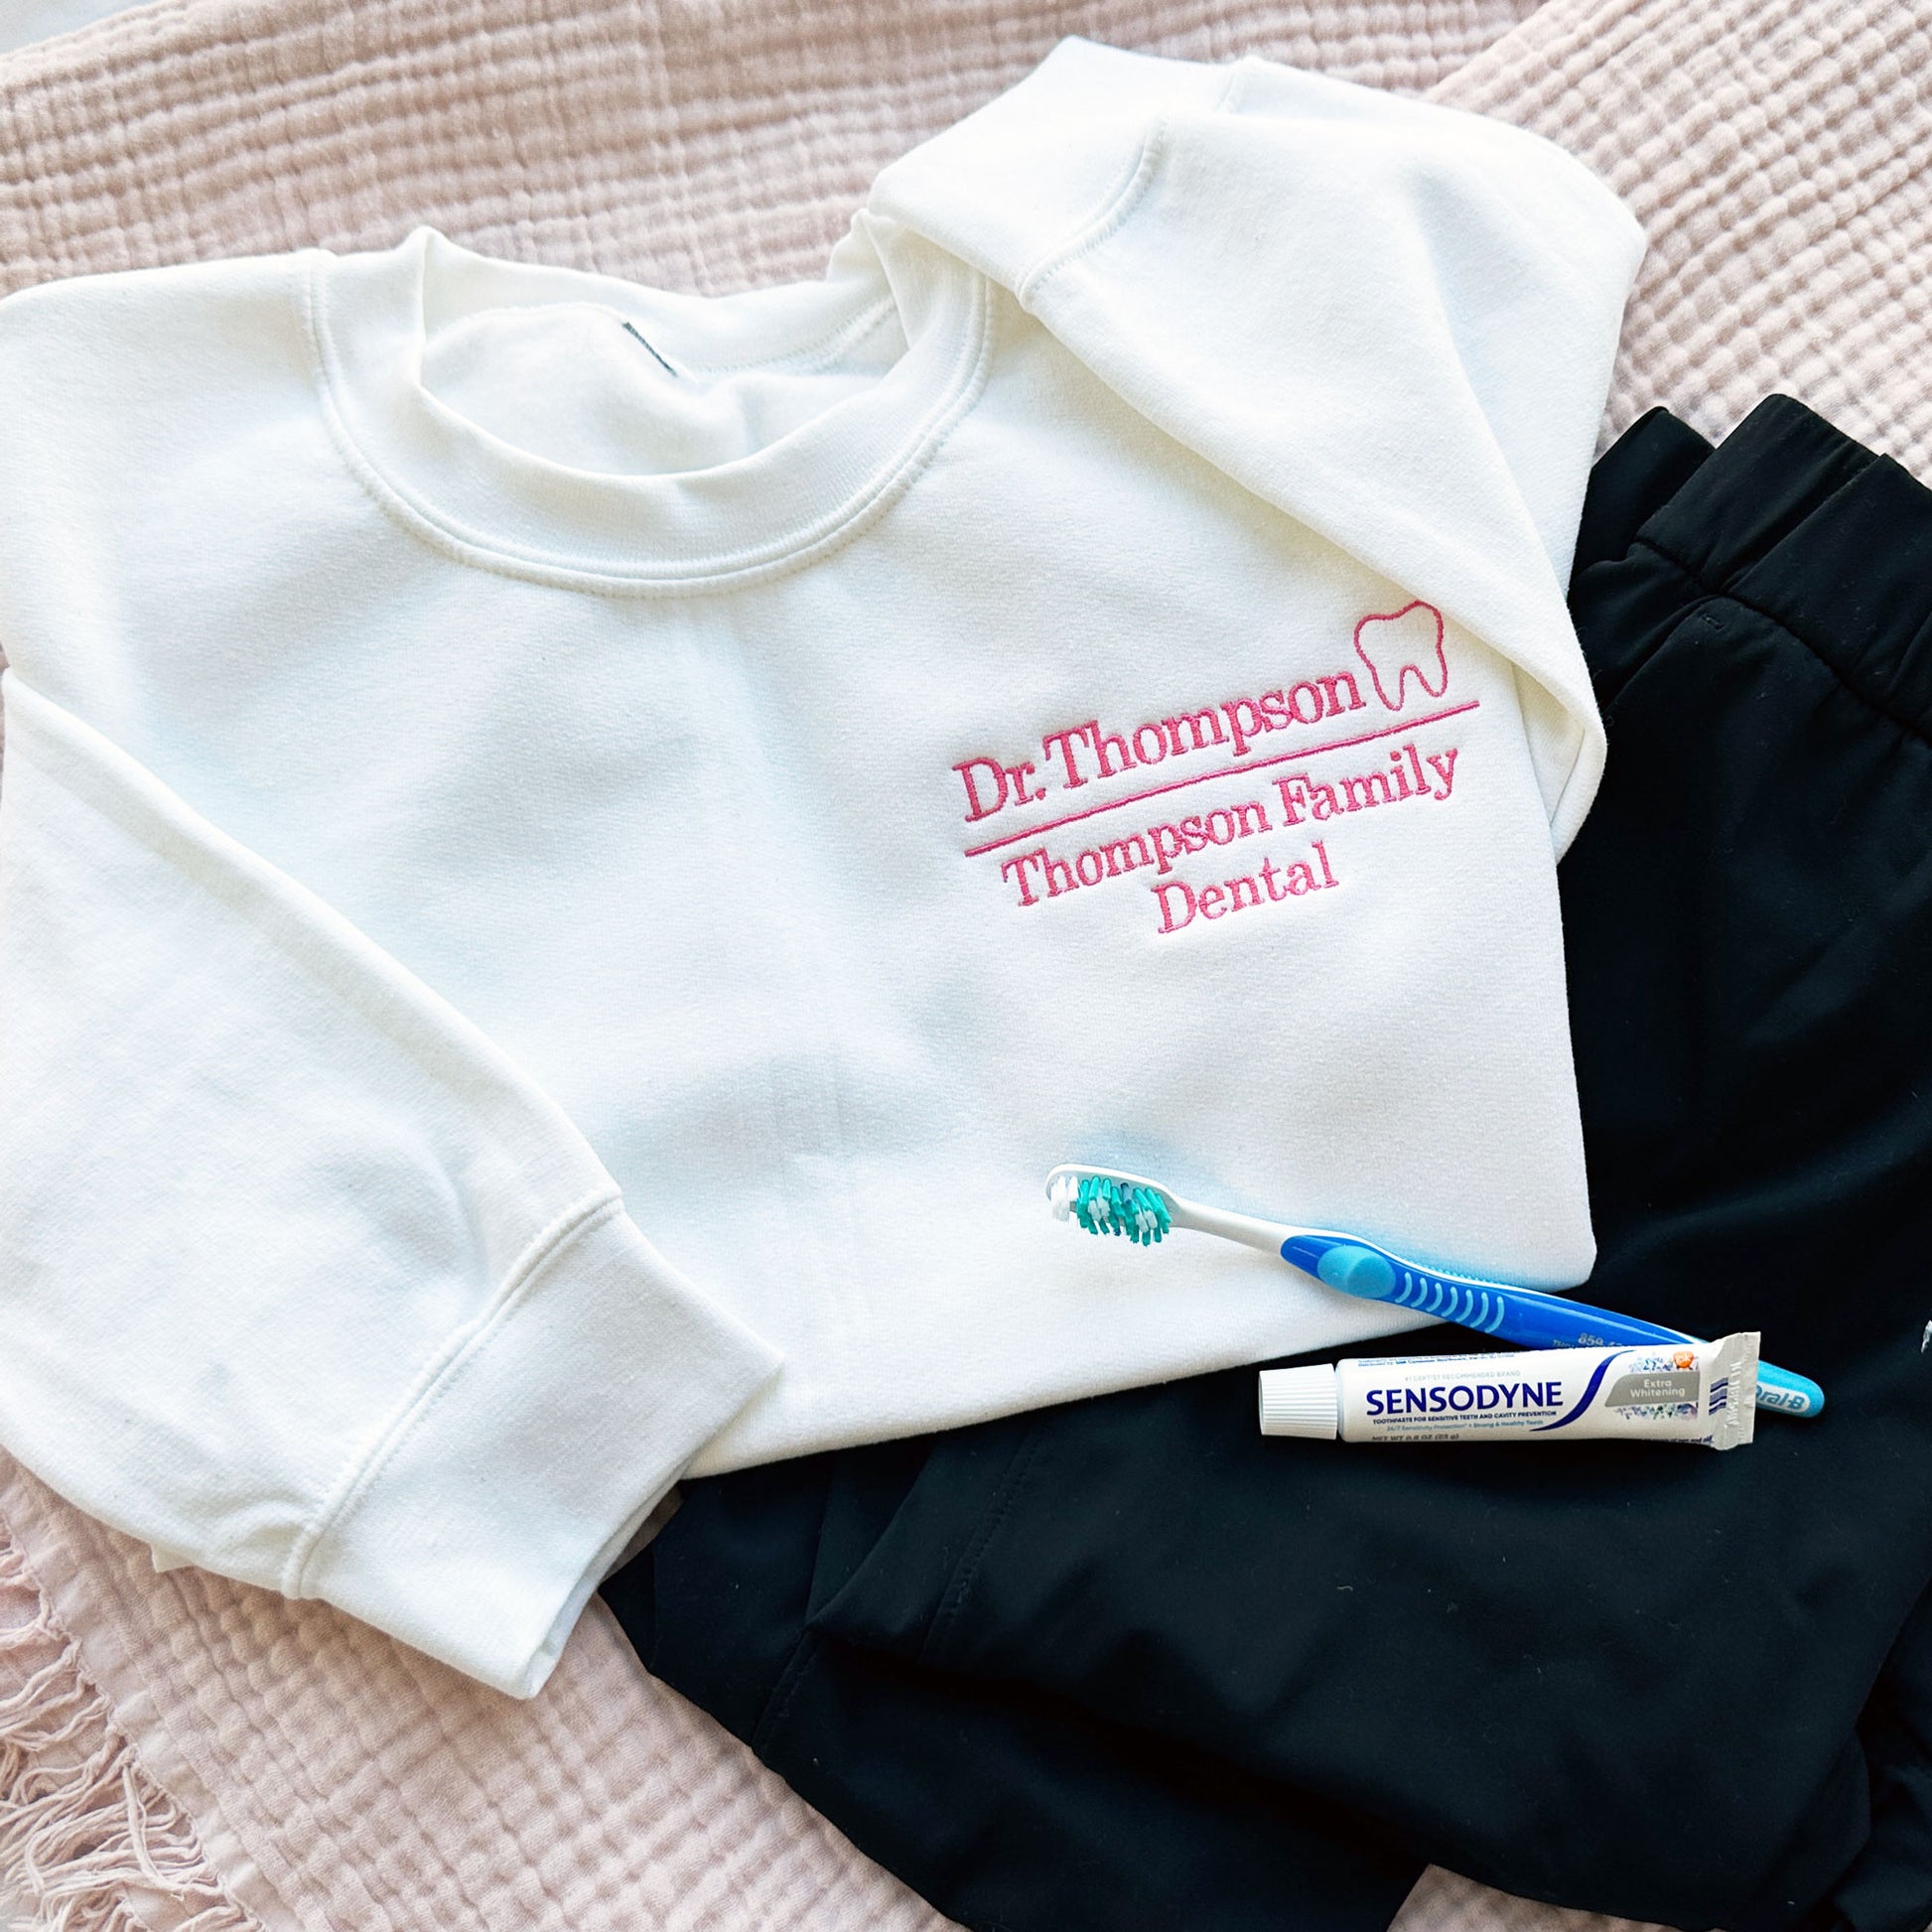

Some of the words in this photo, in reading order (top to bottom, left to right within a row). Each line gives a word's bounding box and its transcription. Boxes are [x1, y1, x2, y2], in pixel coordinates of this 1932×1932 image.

[952, 757, 1046, 823] Dr.
[1042, 670, 1366, 789] Thompson
[1000, 800, 1273, 906] Thompson
[1272, 744, 1458, 827] Family
[1152, 840, 1339, 934] Dental
[1366, 1381, 1564, 1416] SENSODYNE
[1629, 1387, 1686, 1398] Whitening
[1643, 1379, 1673, 1388] Extra
[1373, 1416, 1413, 1425] TOOTHPASTE
[1428, 1414, 1458, 1423] SENSITIVE
